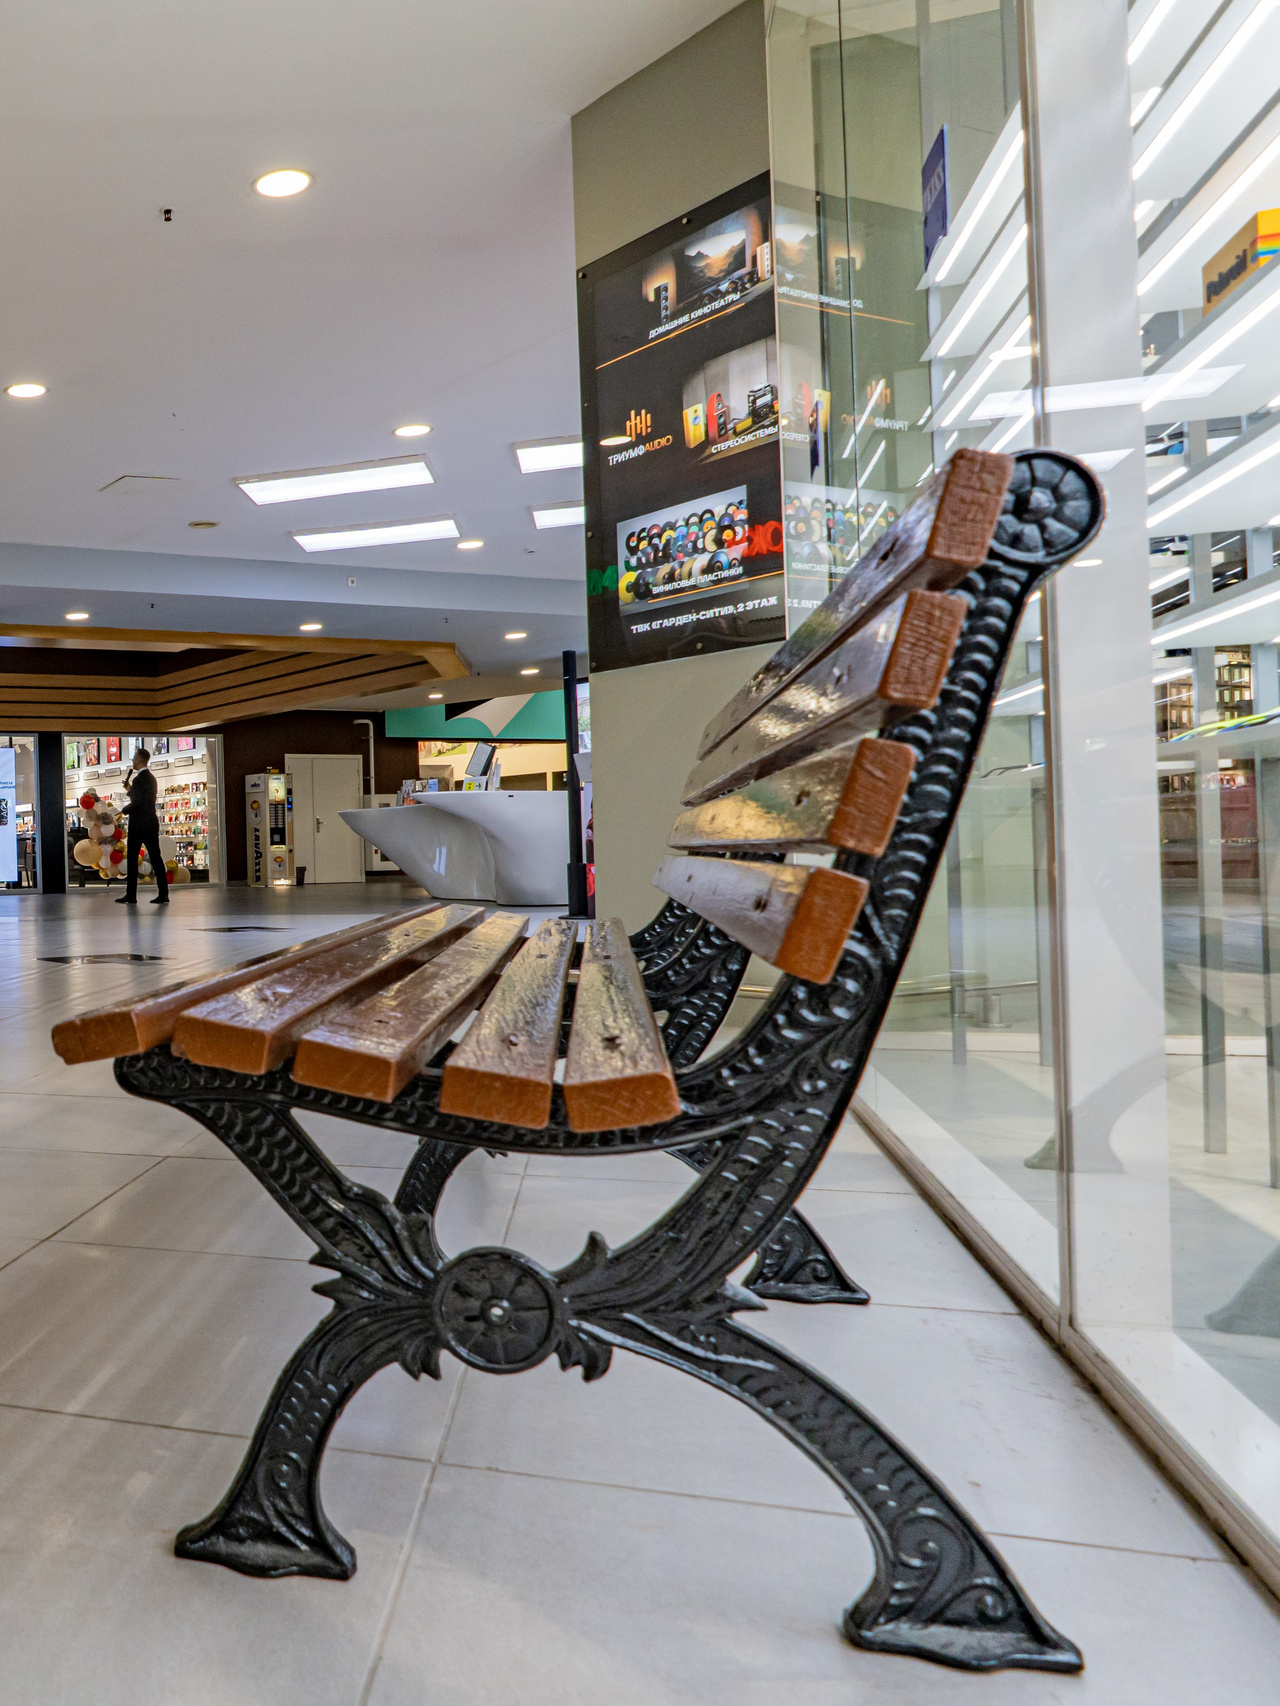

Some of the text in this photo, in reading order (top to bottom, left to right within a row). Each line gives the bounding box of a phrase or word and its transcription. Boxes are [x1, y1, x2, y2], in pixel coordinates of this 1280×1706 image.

[648, 292, 741, 339] ДОМАШНИЕ КИНОТЕАТРЫ
[711, 425, 779, 454] СТЕРЕОСИСТЕМЫ
[652, 566, 743, 594] ВИНИЛОВЫЕ ПЛАСТИНКИ
[631, 622, 651, 634] ТВК
[737, 603, 745, 612] 2
[745, 595, 778, 611] ЭТАЖ
